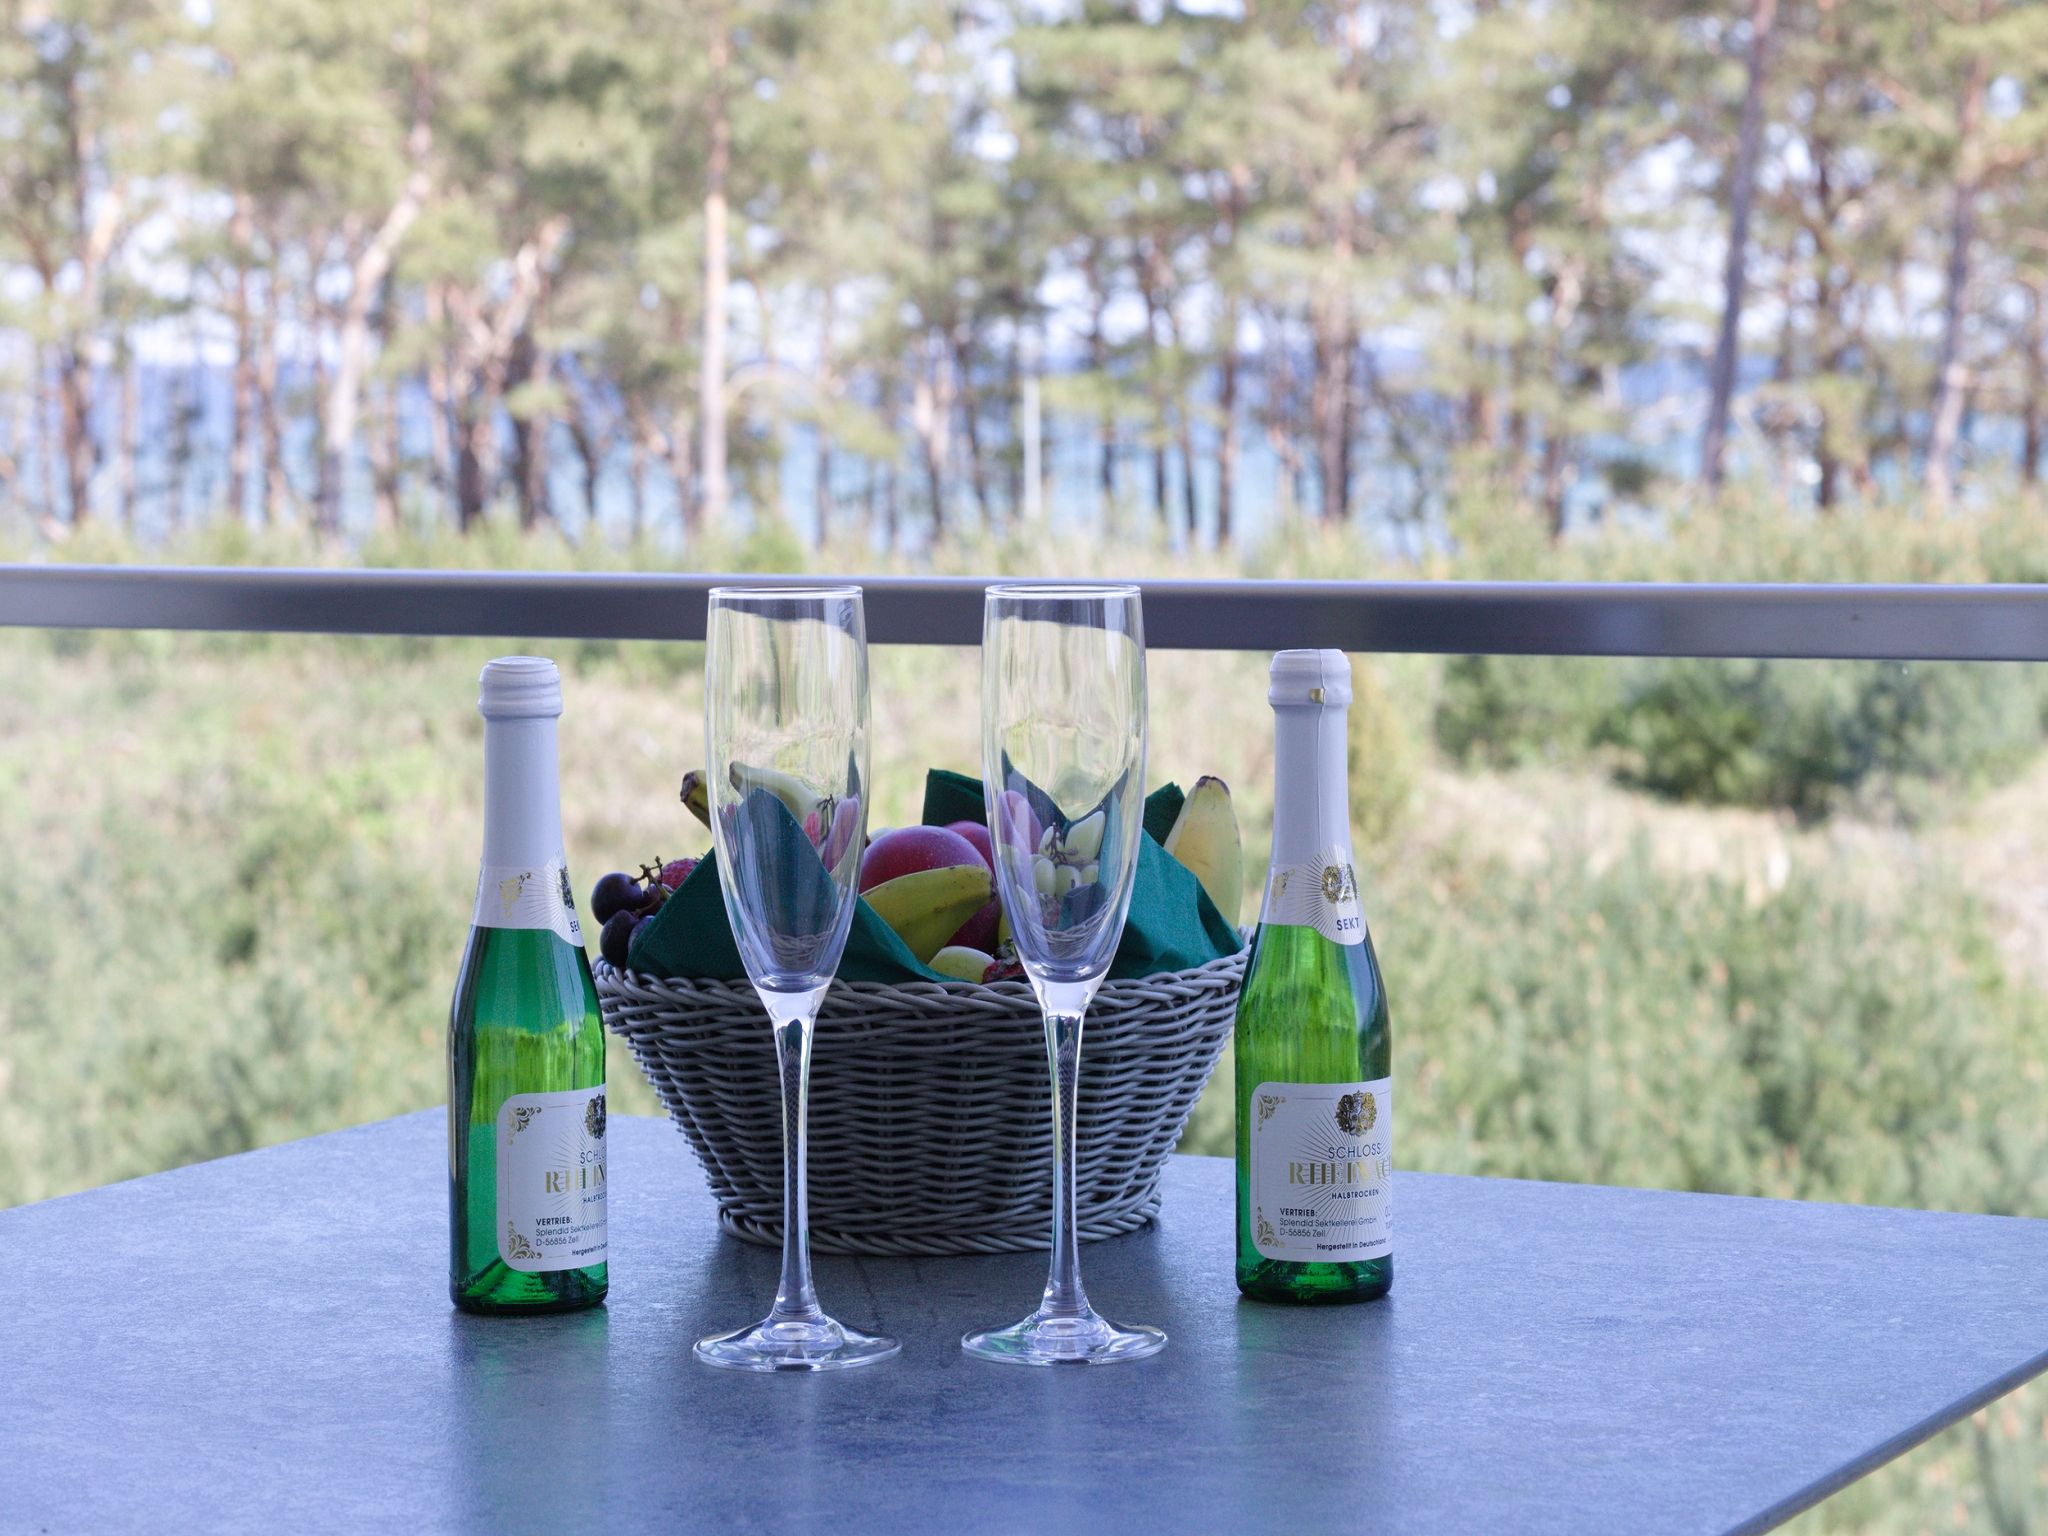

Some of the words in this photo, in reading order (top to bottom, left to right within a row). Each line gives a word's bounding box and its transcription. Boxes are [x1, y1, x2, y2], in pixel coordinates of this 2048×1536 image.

[1337, 918, 1360, 931] SEKT
[1328, 1143, 1382, 1160] SCHLOSS
[1331, 1189, 1380, 1200] HALBTROCKEN
[1280, 1208, 1318, 1218] VERTRIEB:
[536, 1216, 573, 1227] VERTRIEB:
[1279, 1218, 1314, 1228] Splendid
[1315, 1219, 1357, 1228] Sektkellerei
[536, 1227, 569, 1237] Splendid
[1280, 1228, 1311, 1237] D-56856
[1312, 1230, 1326, 1238] Zell
[536, 1236, 567, 1247] D-56856
[1317, 1243, 1351, 1252] Hergestellt
